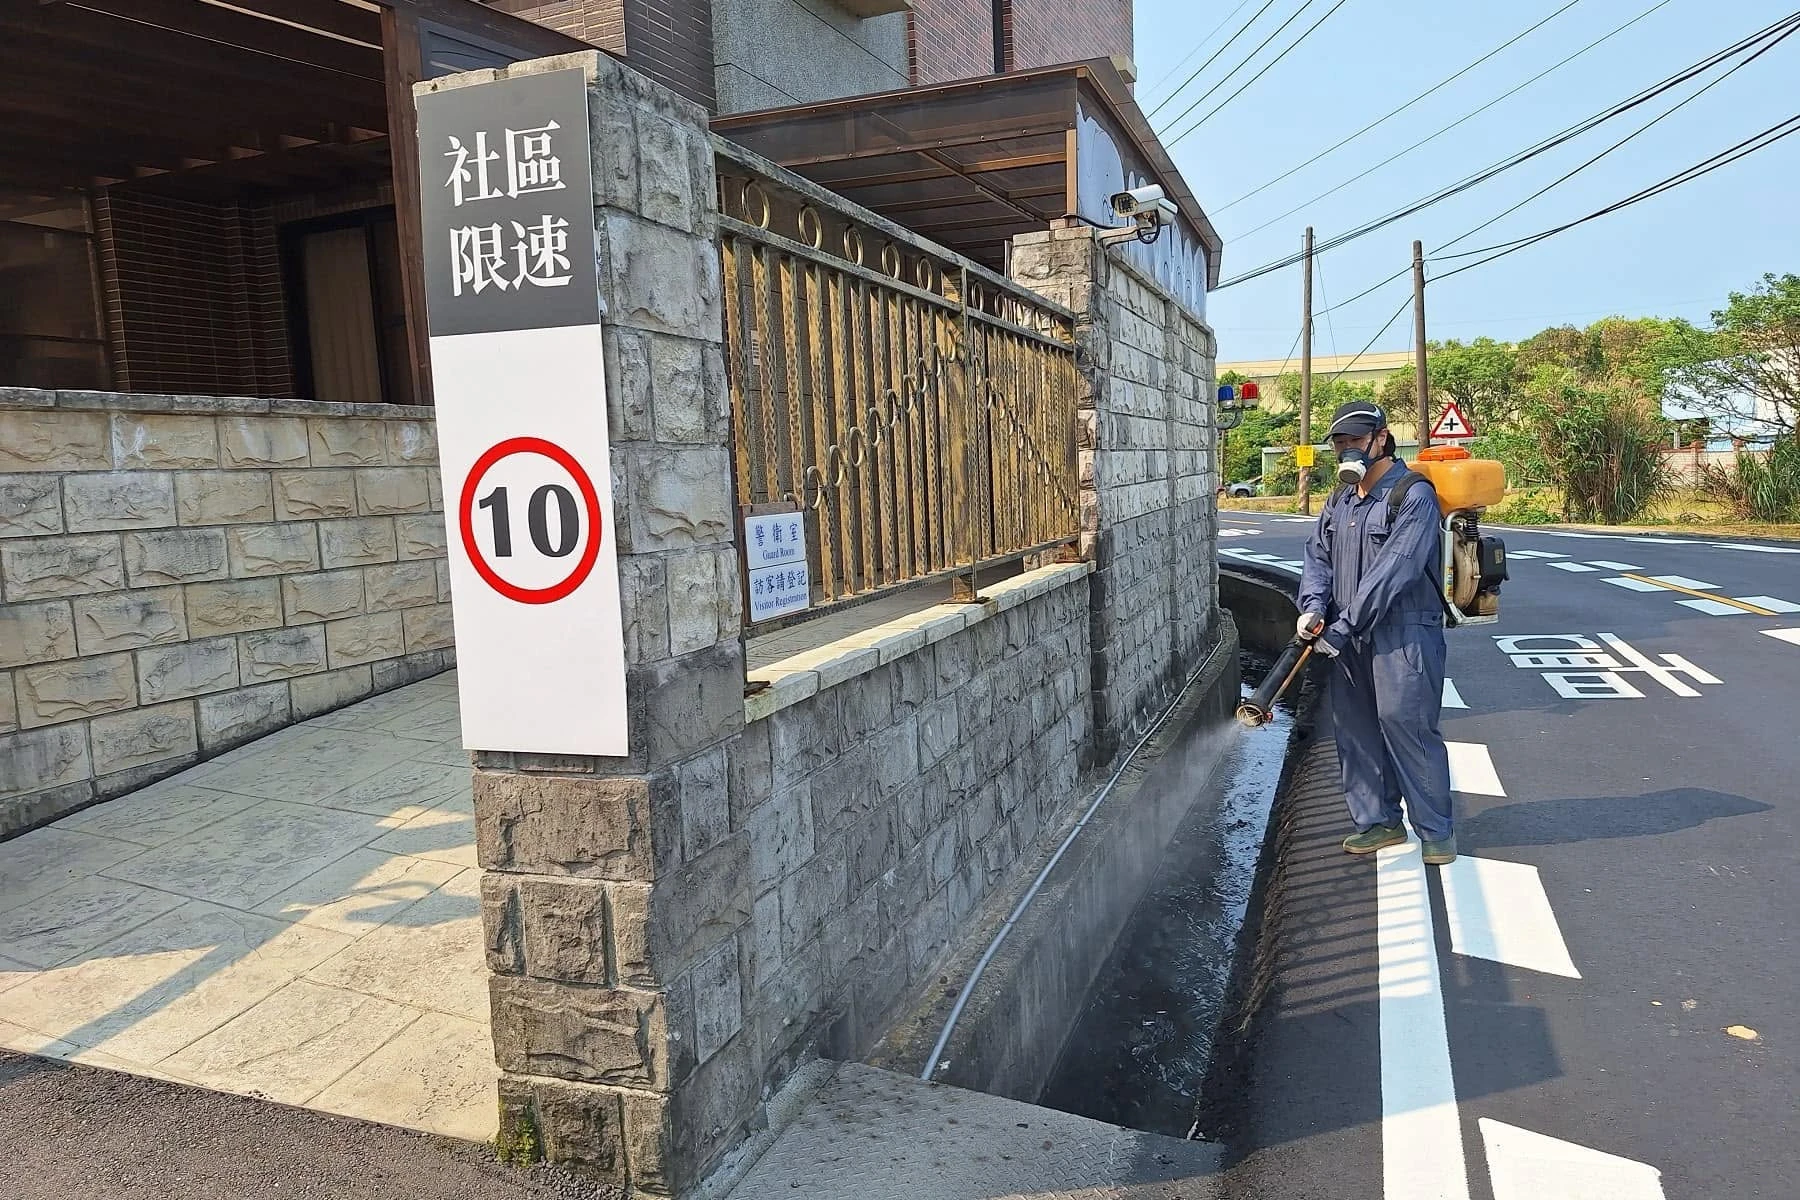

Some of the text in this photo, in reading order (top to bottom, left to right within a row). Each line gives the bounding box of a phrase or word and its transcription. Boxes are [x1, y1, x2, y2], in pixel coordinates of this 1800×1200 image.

[444, 120, 566, 207] 社區
[450, 215, 573, 296] 限速
[479, 484, 579, 557] 10
[755, 523, 798, 546] 警衛室
[763, 547, 795, 560] Guard Room
[754, 570, 806, 594] 訪客請登記
[754, 592, 807, 611] Visitor Registration
[1491, 632, 1724, 698] 慢
